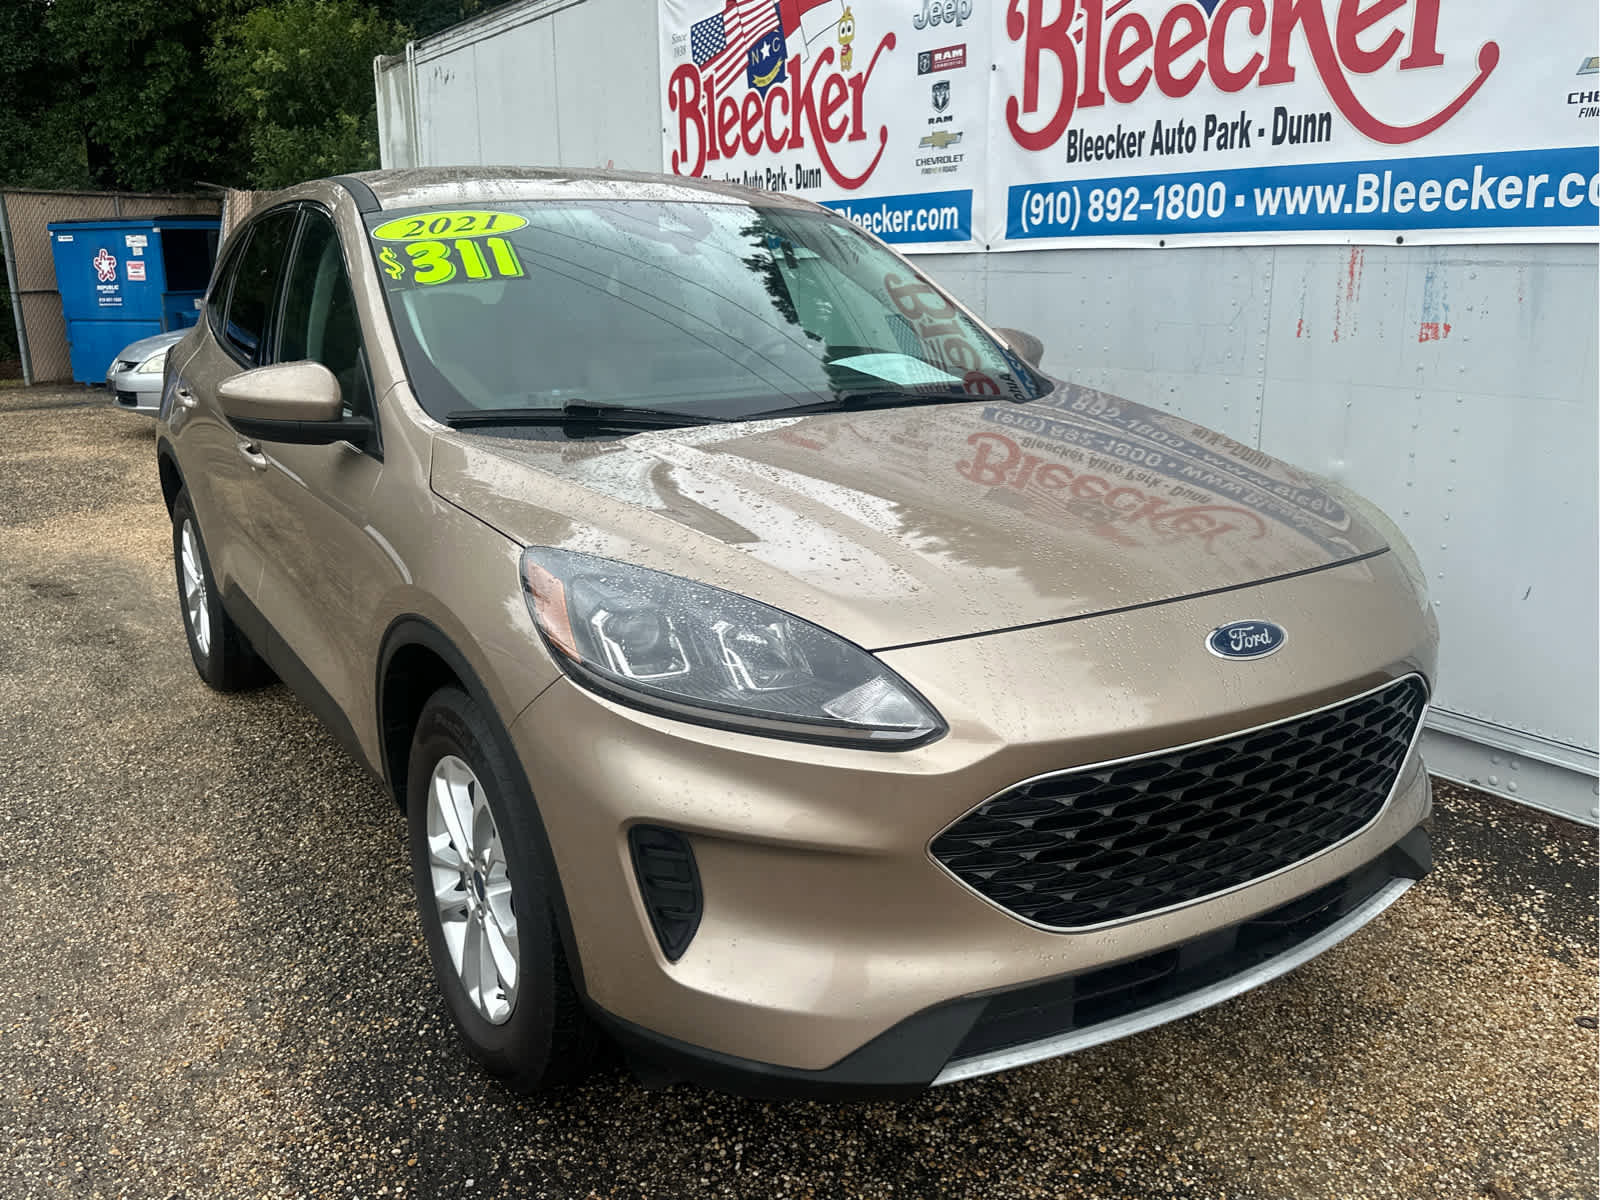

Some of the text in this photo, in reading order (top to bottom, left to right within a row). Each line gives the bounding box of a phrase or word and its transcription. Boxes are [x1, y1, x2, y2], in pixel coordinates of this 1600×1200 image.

[913, 0, 972, 30] Jeep
[934, 49, 963, 61] RAM
[1006, 0, 1500, 151] Bleecker
[668, 32, 896, 190] Bleecker
[928, 115, 953, 124] RAM
[1066, 106, 1333, 163] Bleecker Auto Park Dunn
[915, 154, 964, 166] CHEVROLET
[766, 166, 788, 192] Park
[796, 164, 821, 190] Dunn
[1021, 186, 1081, 232] (910)
[1088, 181, 1226, 222] 892-1800
[401, 214, 499, 238] 2021
[1228, 626, 1273, 651] Ford
